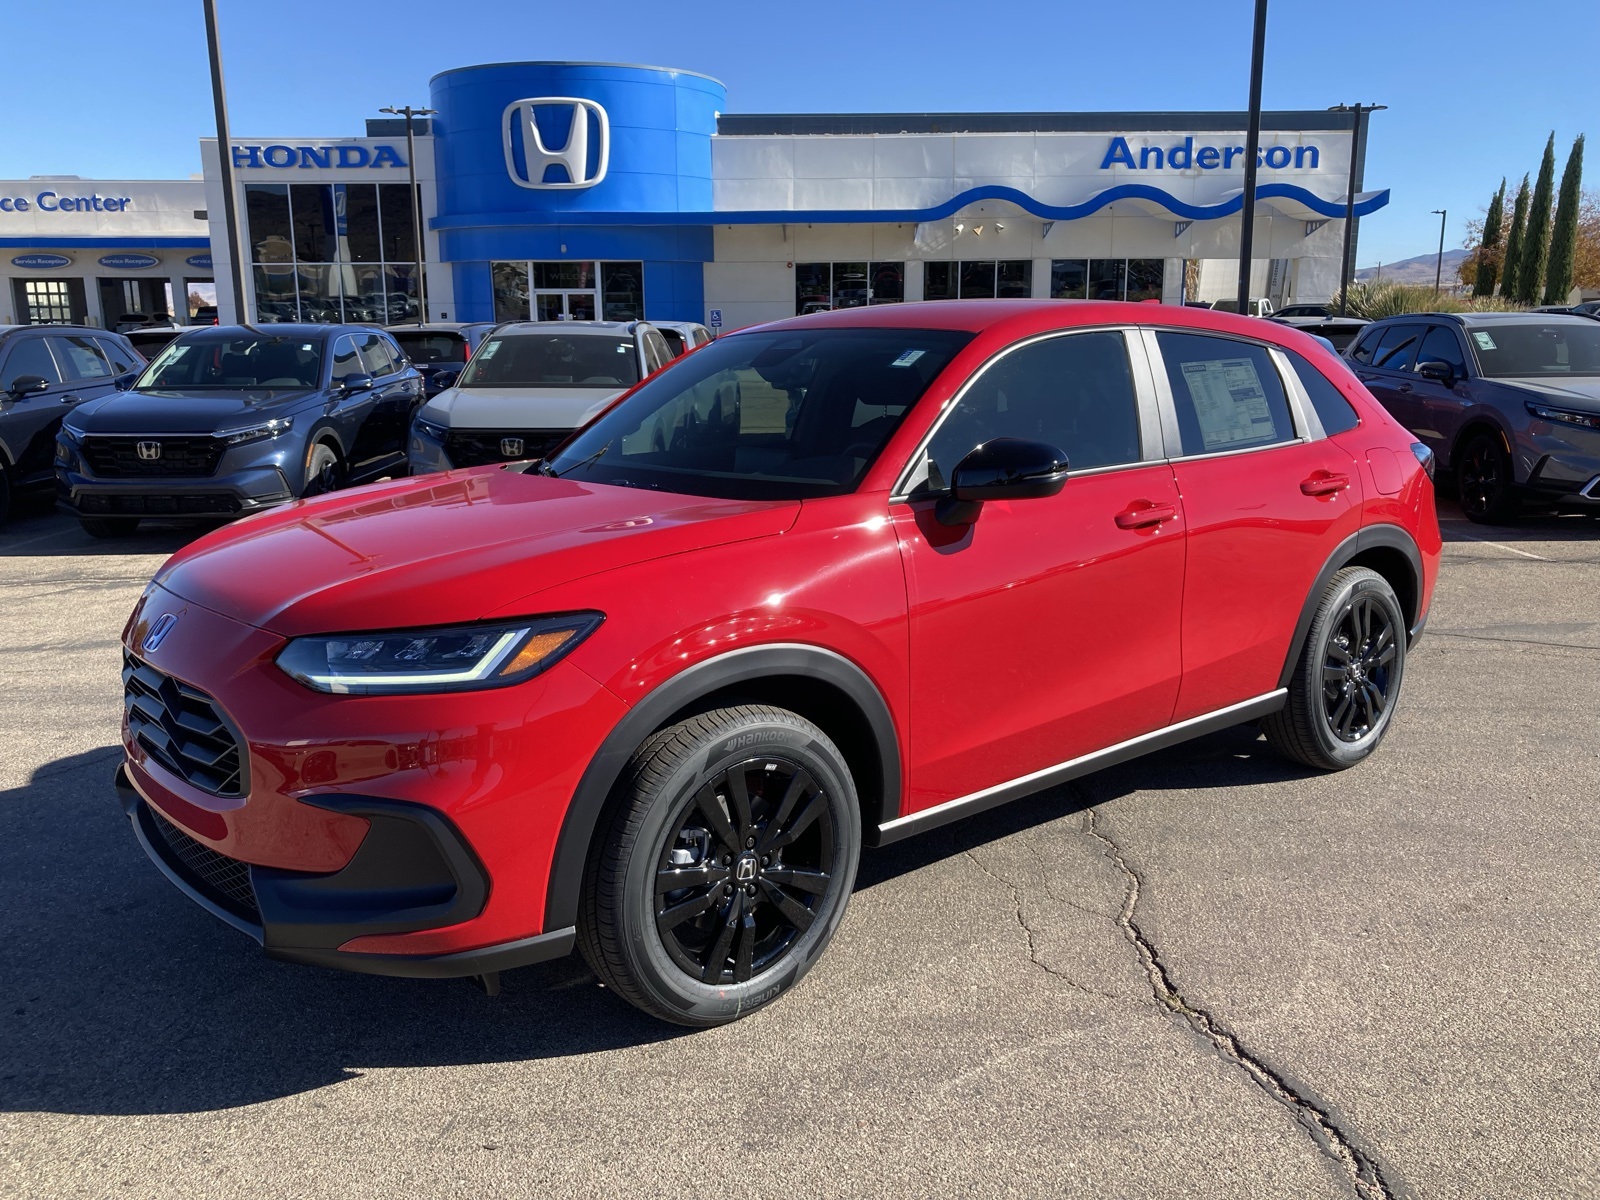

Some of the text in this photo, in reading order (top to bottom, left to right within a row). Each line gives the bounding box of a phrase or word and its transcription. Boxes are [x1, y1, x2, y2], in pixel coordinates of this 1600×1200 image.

[232, 144, 408, 169] HONDA
[36, 191, 132, 212] Center
[14, 257, 68, 266] Service Reception
[101, 257, 155, 266] Service Reception
